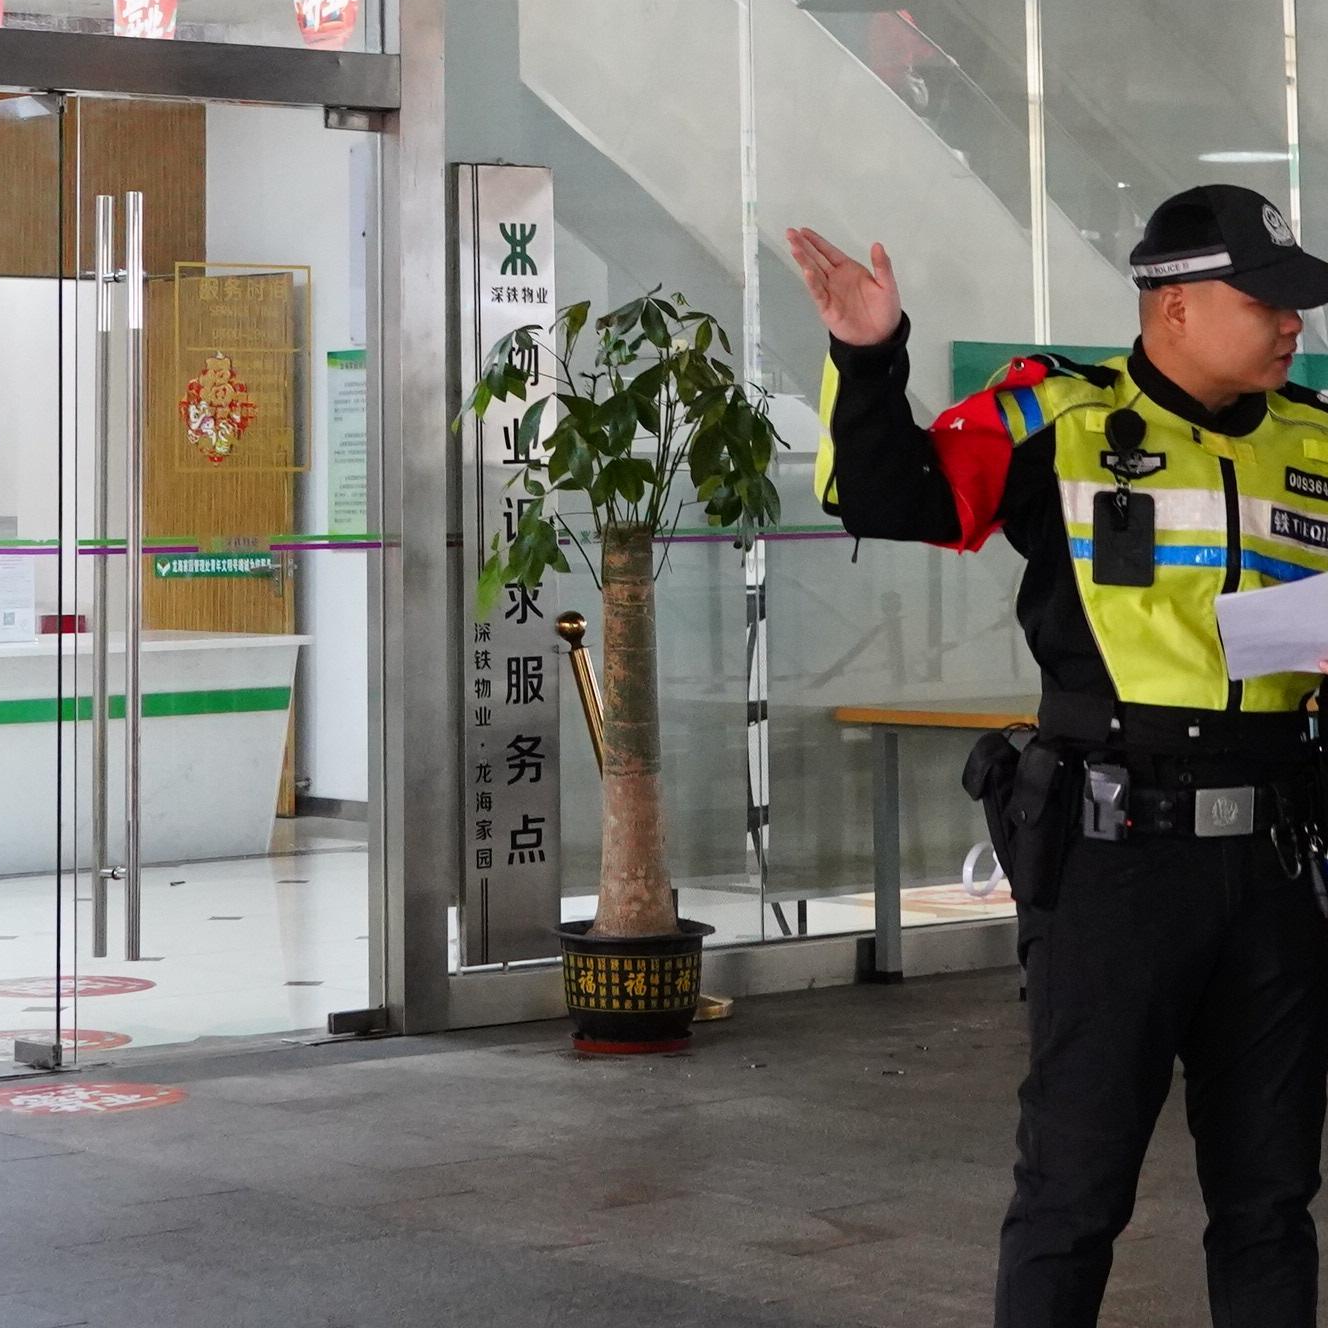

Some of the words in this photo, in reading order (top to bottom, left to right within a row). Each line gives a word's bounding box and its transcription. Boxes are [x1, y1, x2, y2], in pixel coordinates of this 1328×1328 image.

[491, 285, 549, 305] 深铁物业
[623, 971, 648, 997] 福
